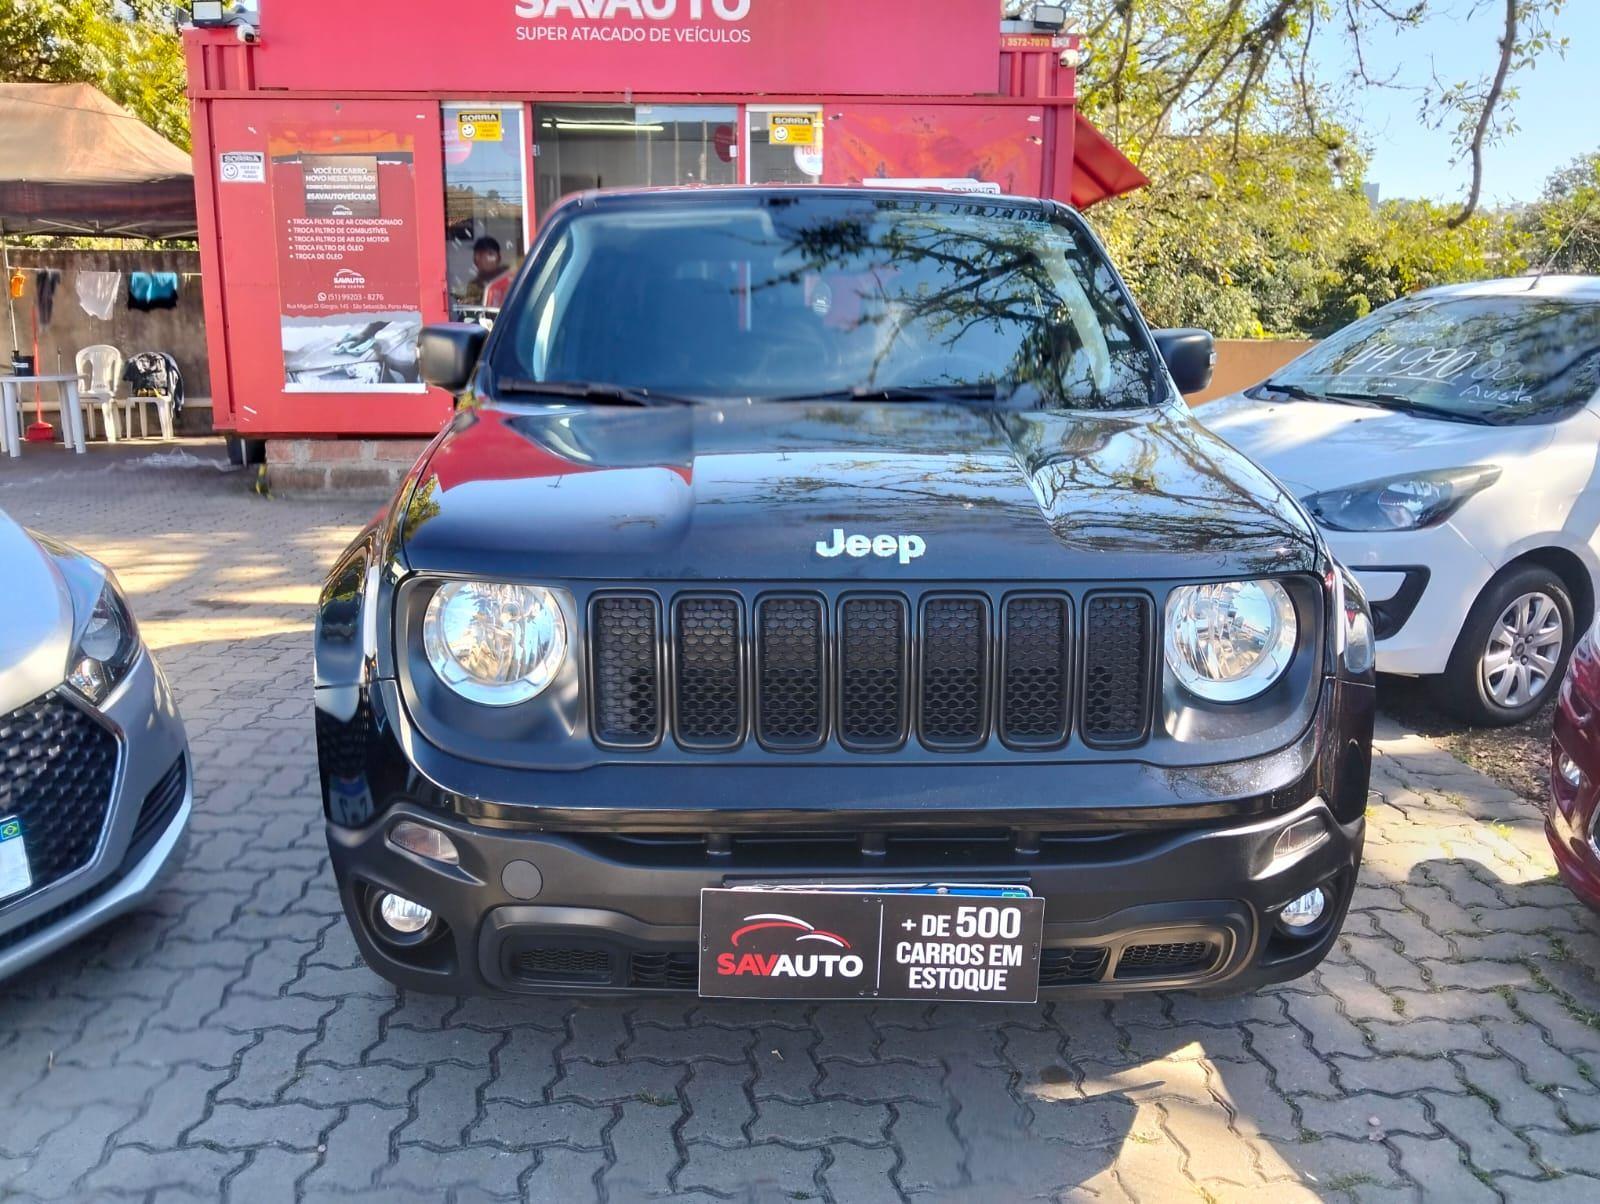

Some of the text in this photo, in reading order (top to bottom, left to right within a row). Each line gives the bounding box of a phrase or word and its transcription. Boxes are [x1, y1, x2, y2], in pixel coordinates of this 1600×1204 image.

[515, 25, 752, 43] SUPER ATACADO DE VEÍCULOS
[461, 114, 497, 122] SORRIA
[774, 117, 810, 125] SORRIA
[346, 226, 388, 234] COMBUSTÍVEL
[326, 252, 343, 260] ÓLEO
[346, 244, 364, 252] ÓLEO
[815, 528, 926, 564] Jeep
[901, 906, 1021, 939] + DE 500
[896, 942, 1023, 966] CARROS EM
[716, 952, 864, 977] SAVAUTO
[908, 967, 1008, 992] ESTOQUE
